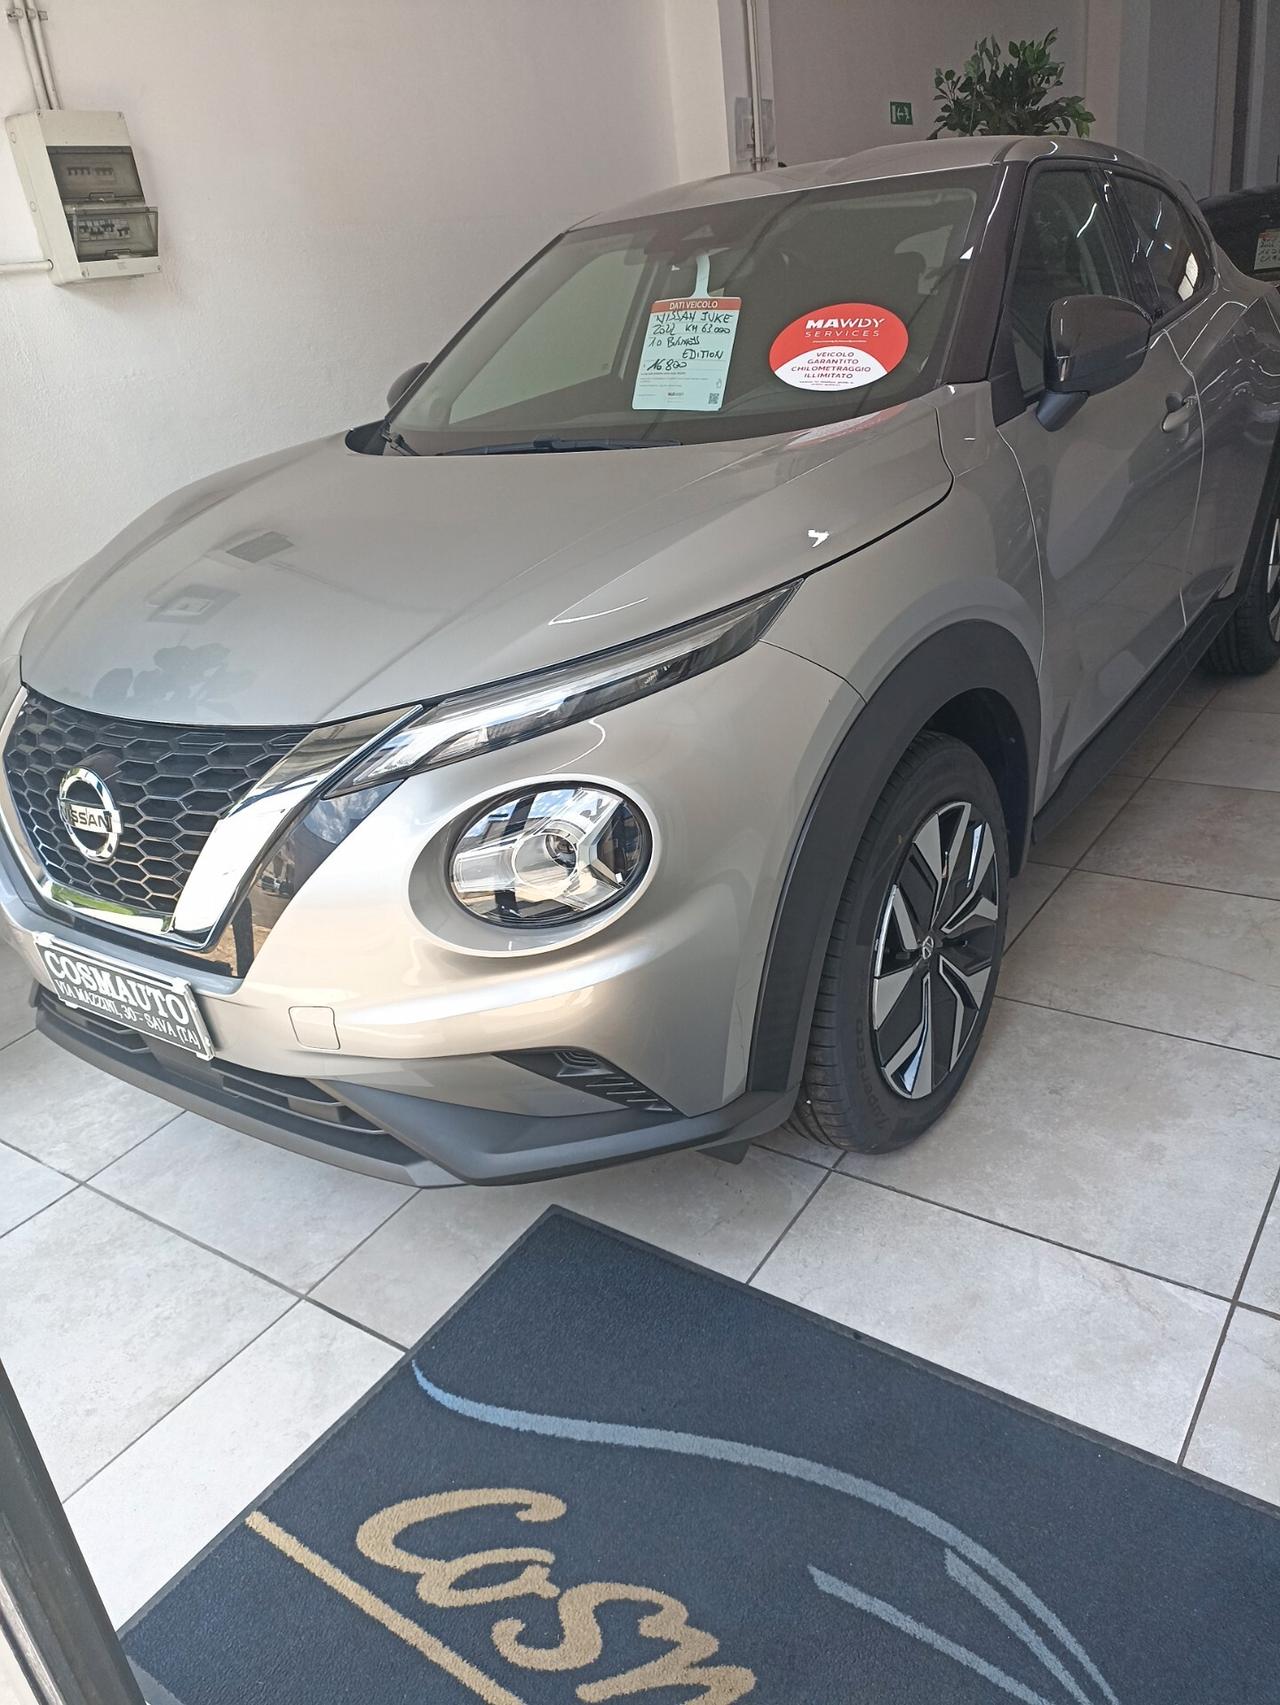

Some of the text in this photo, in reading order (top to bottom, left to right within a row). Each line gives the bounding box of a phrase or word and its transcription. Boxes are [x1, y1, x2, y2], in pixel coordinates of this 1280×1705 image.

[669, 300, 718, 310] DATI VEICOLO
[656, 311, 733, 324] NISSAN JUKE
[805, 318, 885, 329] MAWDY
[805, 330, 880, 338] SERVICES
[682, 348, 723, 360] EDITION
[61, 802, 113, 833] ISSAN
[44, 950, 190, 1025] COSMAUTO
[55, 979, 74, 998] VIA
[144, 1013, 178, 1038] SAVA
